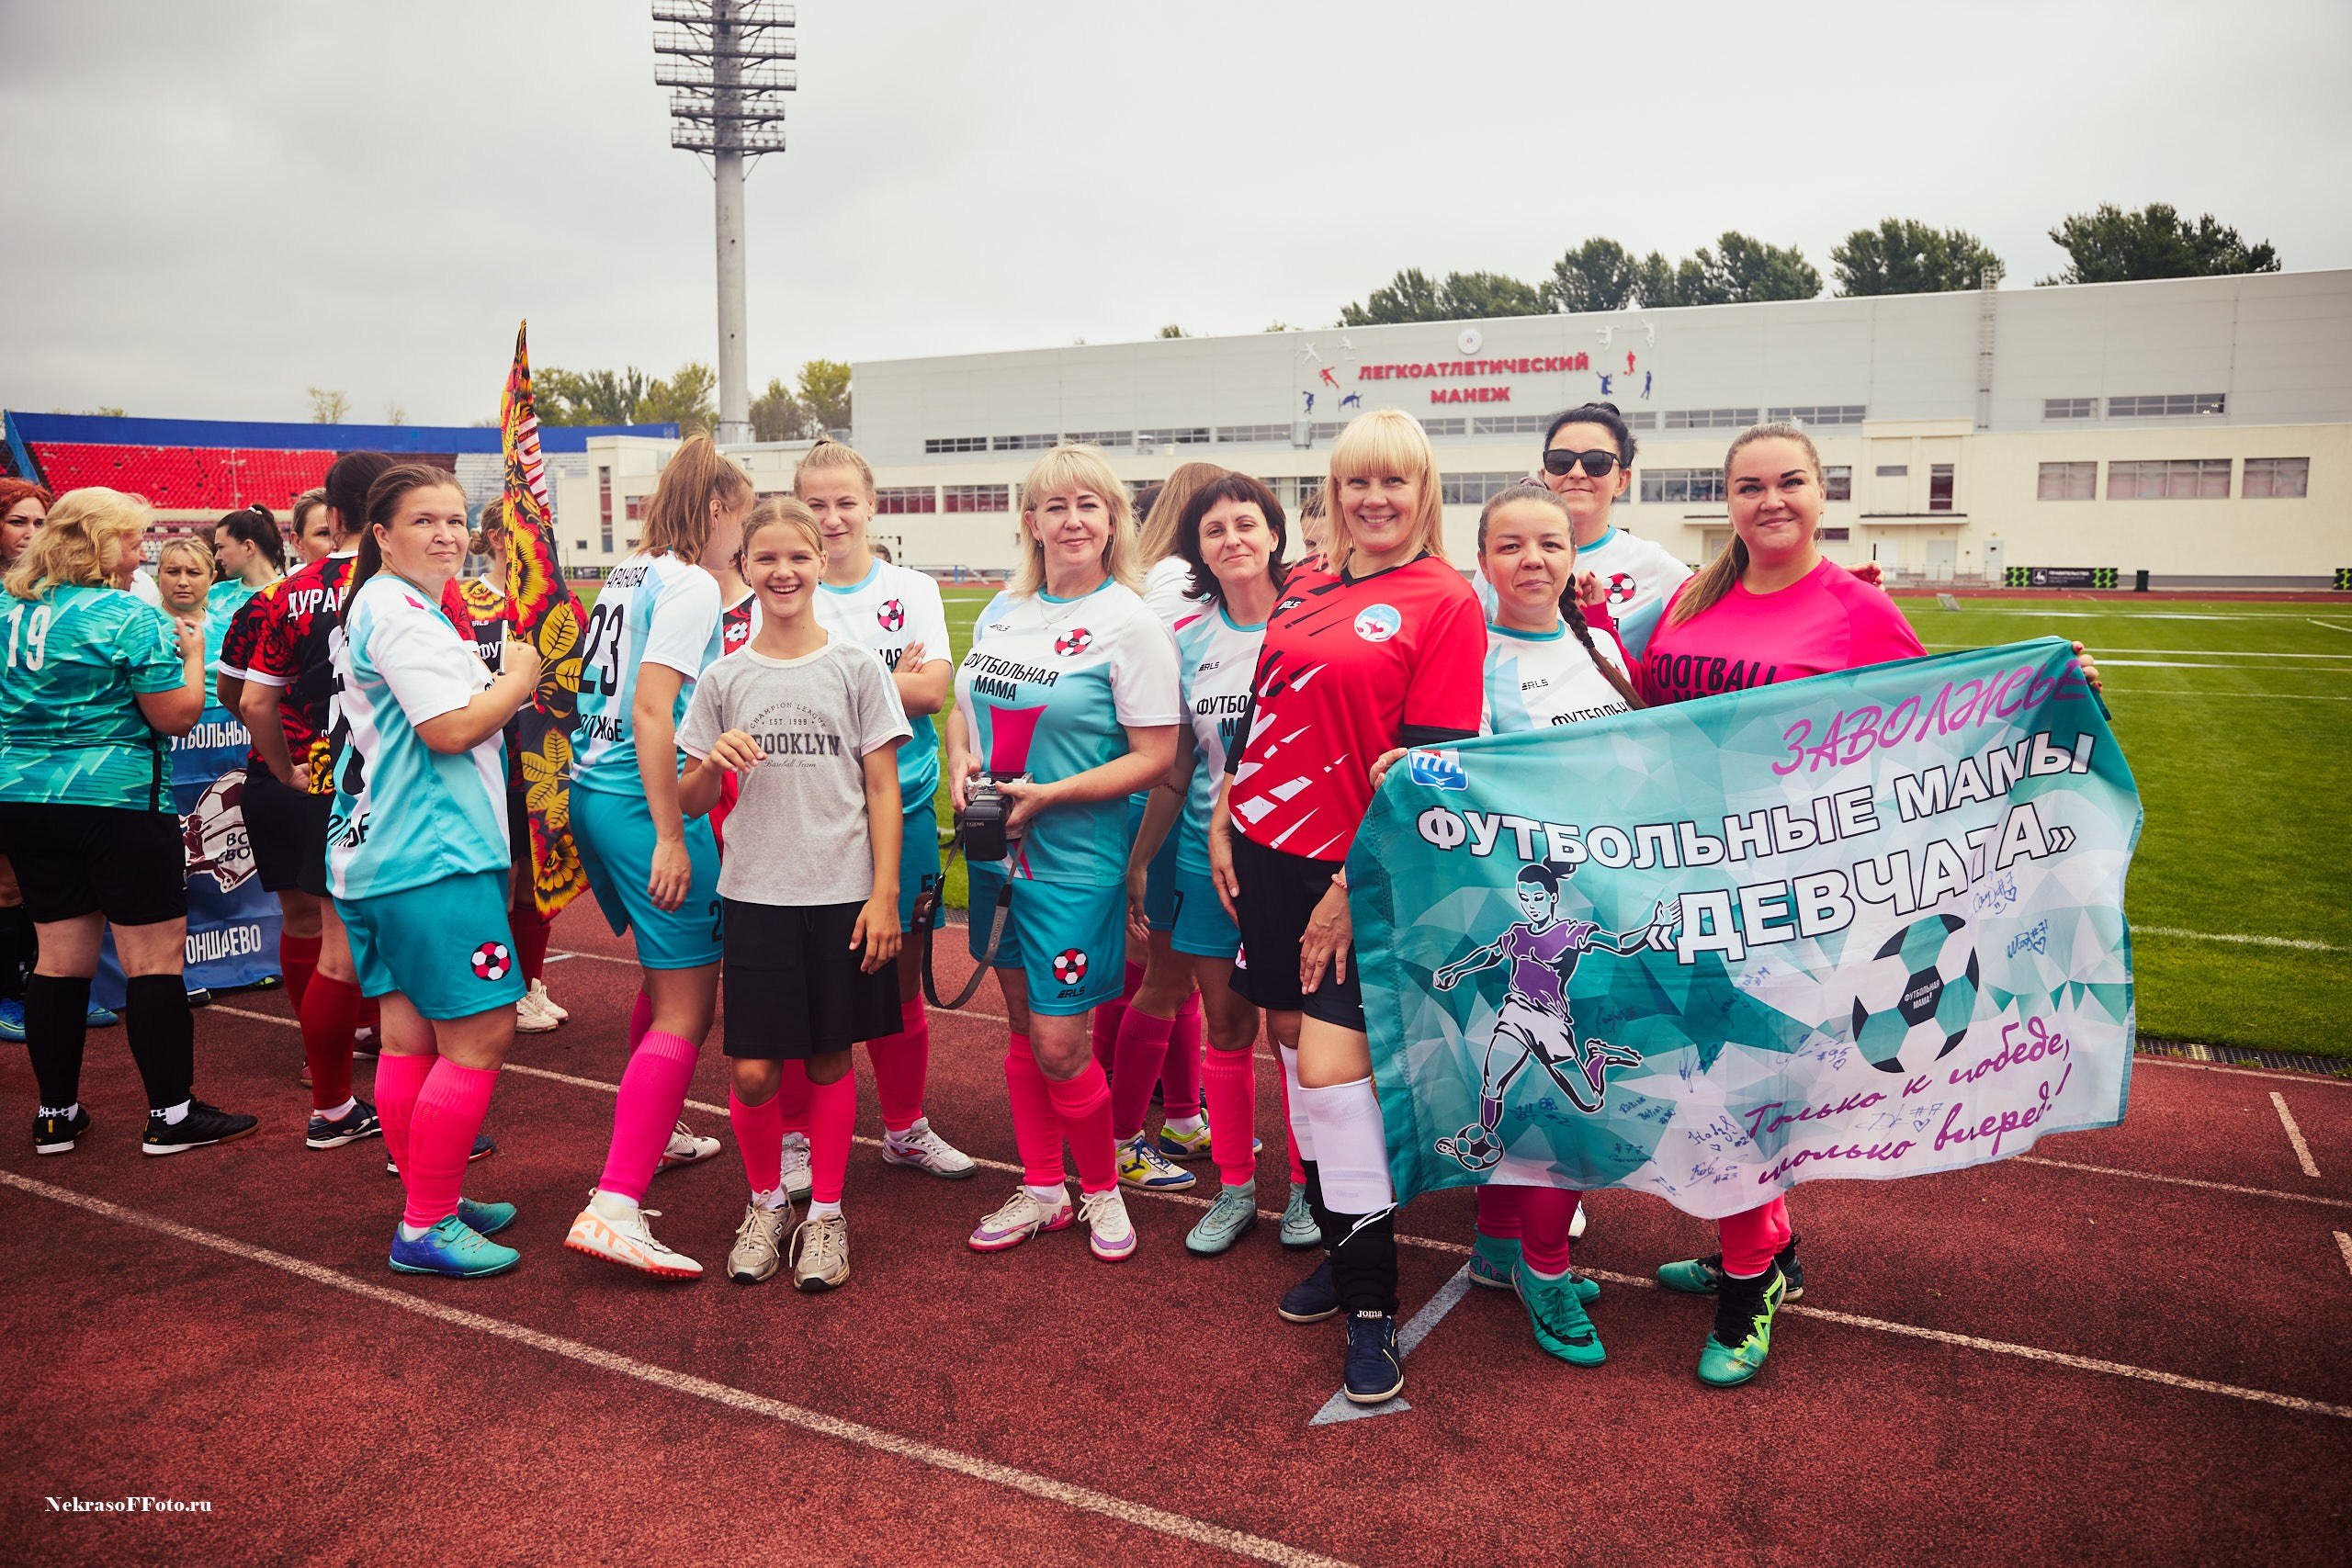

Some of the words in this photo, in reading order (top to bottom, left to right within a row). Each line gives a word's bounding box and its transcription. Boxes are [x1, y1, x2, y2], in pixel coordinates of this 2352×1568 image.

[1358, 352, 1589, 381] ЛЕГКОАТЛЕТИЧЕСКИЙ
[1430, 387, 1510, 404] МАНЕЖ
[7, 604, 51, 671] 19
[578, 603, 625, 697] 23
[964, 653, 1060, 688] ФУТБОЛЬНАЯ
[973, 674, 1018, 702] МАМА
[750, 702, 793, 729] CHAMPION
[796, 704, 827, 728] LEAGUE
[1771, 659, 2088, 776] ЗАВОЛЖЬЕ
[763, 758, 797, 768] Baseball
[795, 760, 816, 768] Team
[1416, 784, 1880, 870] ФУТБОЛЬНЫЕ
[1894, 731, 2096, 823] МАМЫ
[1904, 979, 1940, 1002] ФУТБОЛЬНАЯ
[1745, 1091, 1887, 1139] Только
[1902, 1074, 1933, 1099] к
[1758, 1140, 1917, 1184] только
